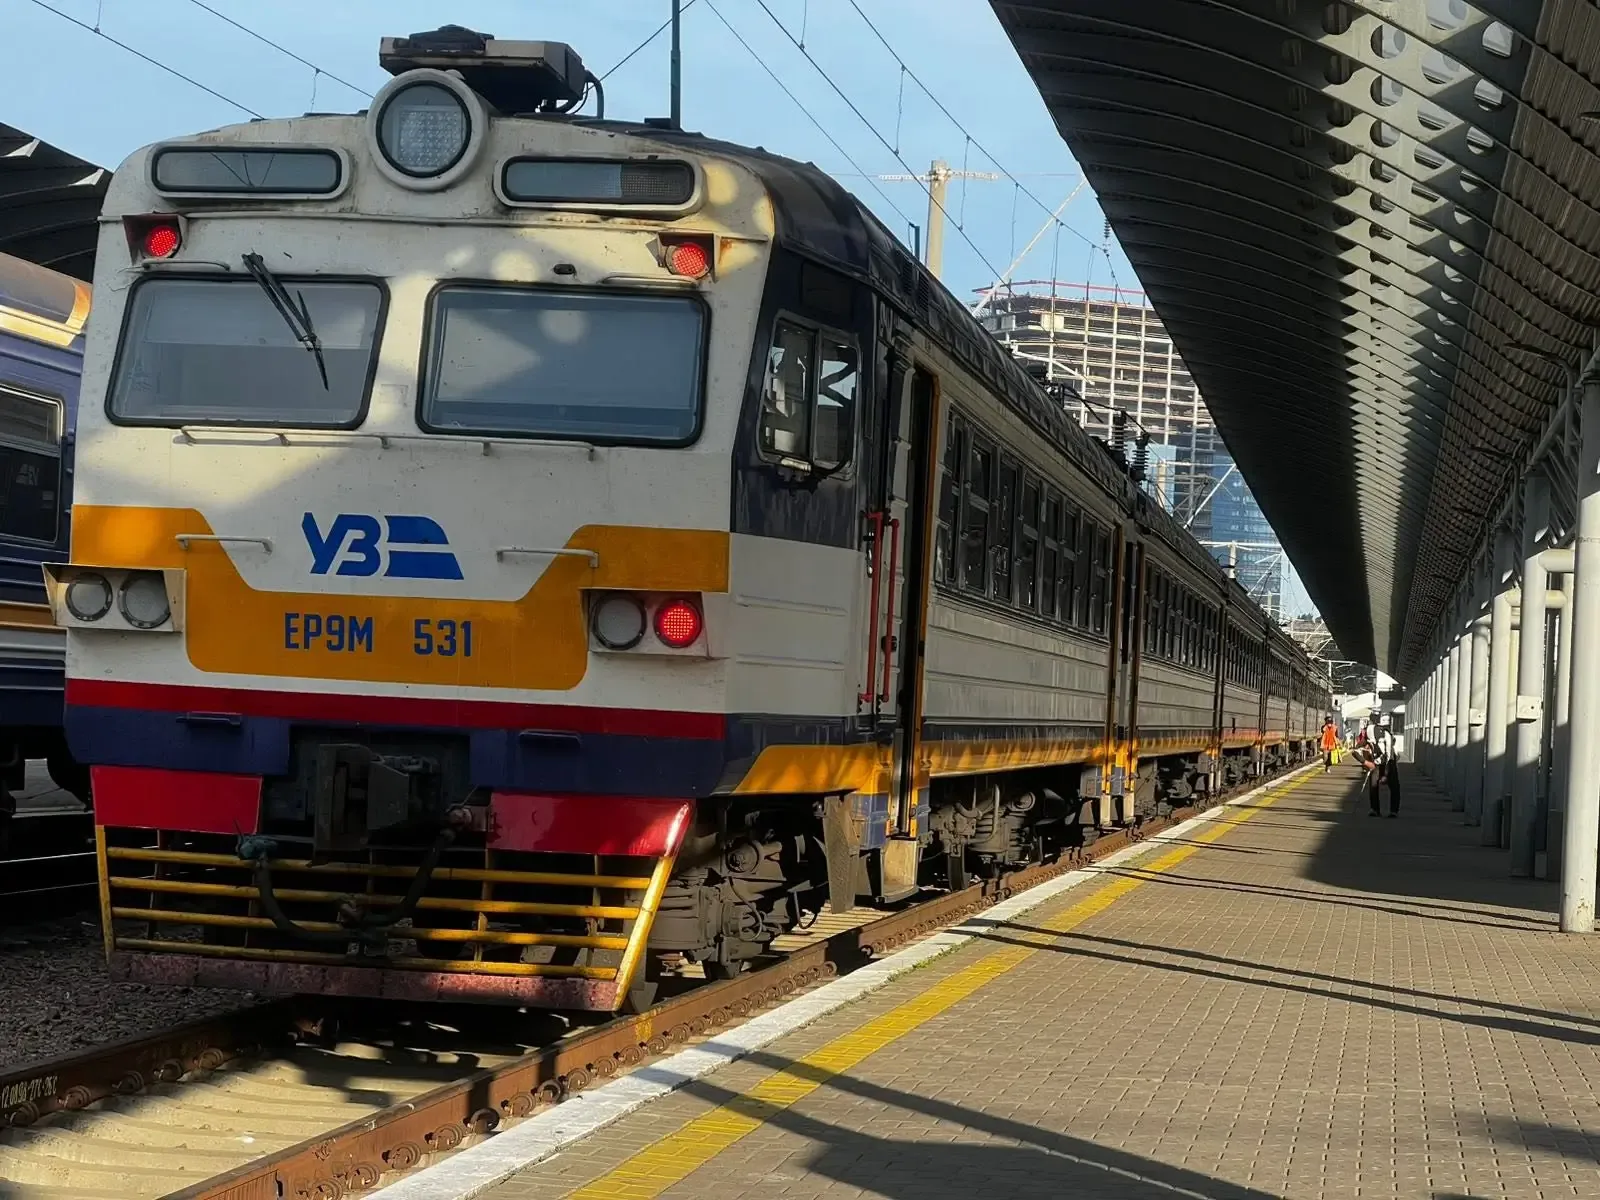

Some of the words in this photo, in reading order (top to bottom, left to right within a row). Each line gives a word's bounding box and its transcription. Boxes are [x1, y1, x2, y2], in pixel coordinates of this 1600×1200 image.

[301, 511, 382, 577] УЗ
[284, 612, 374, 652] ЕР9М
[413, 618, 472, 657] 531
